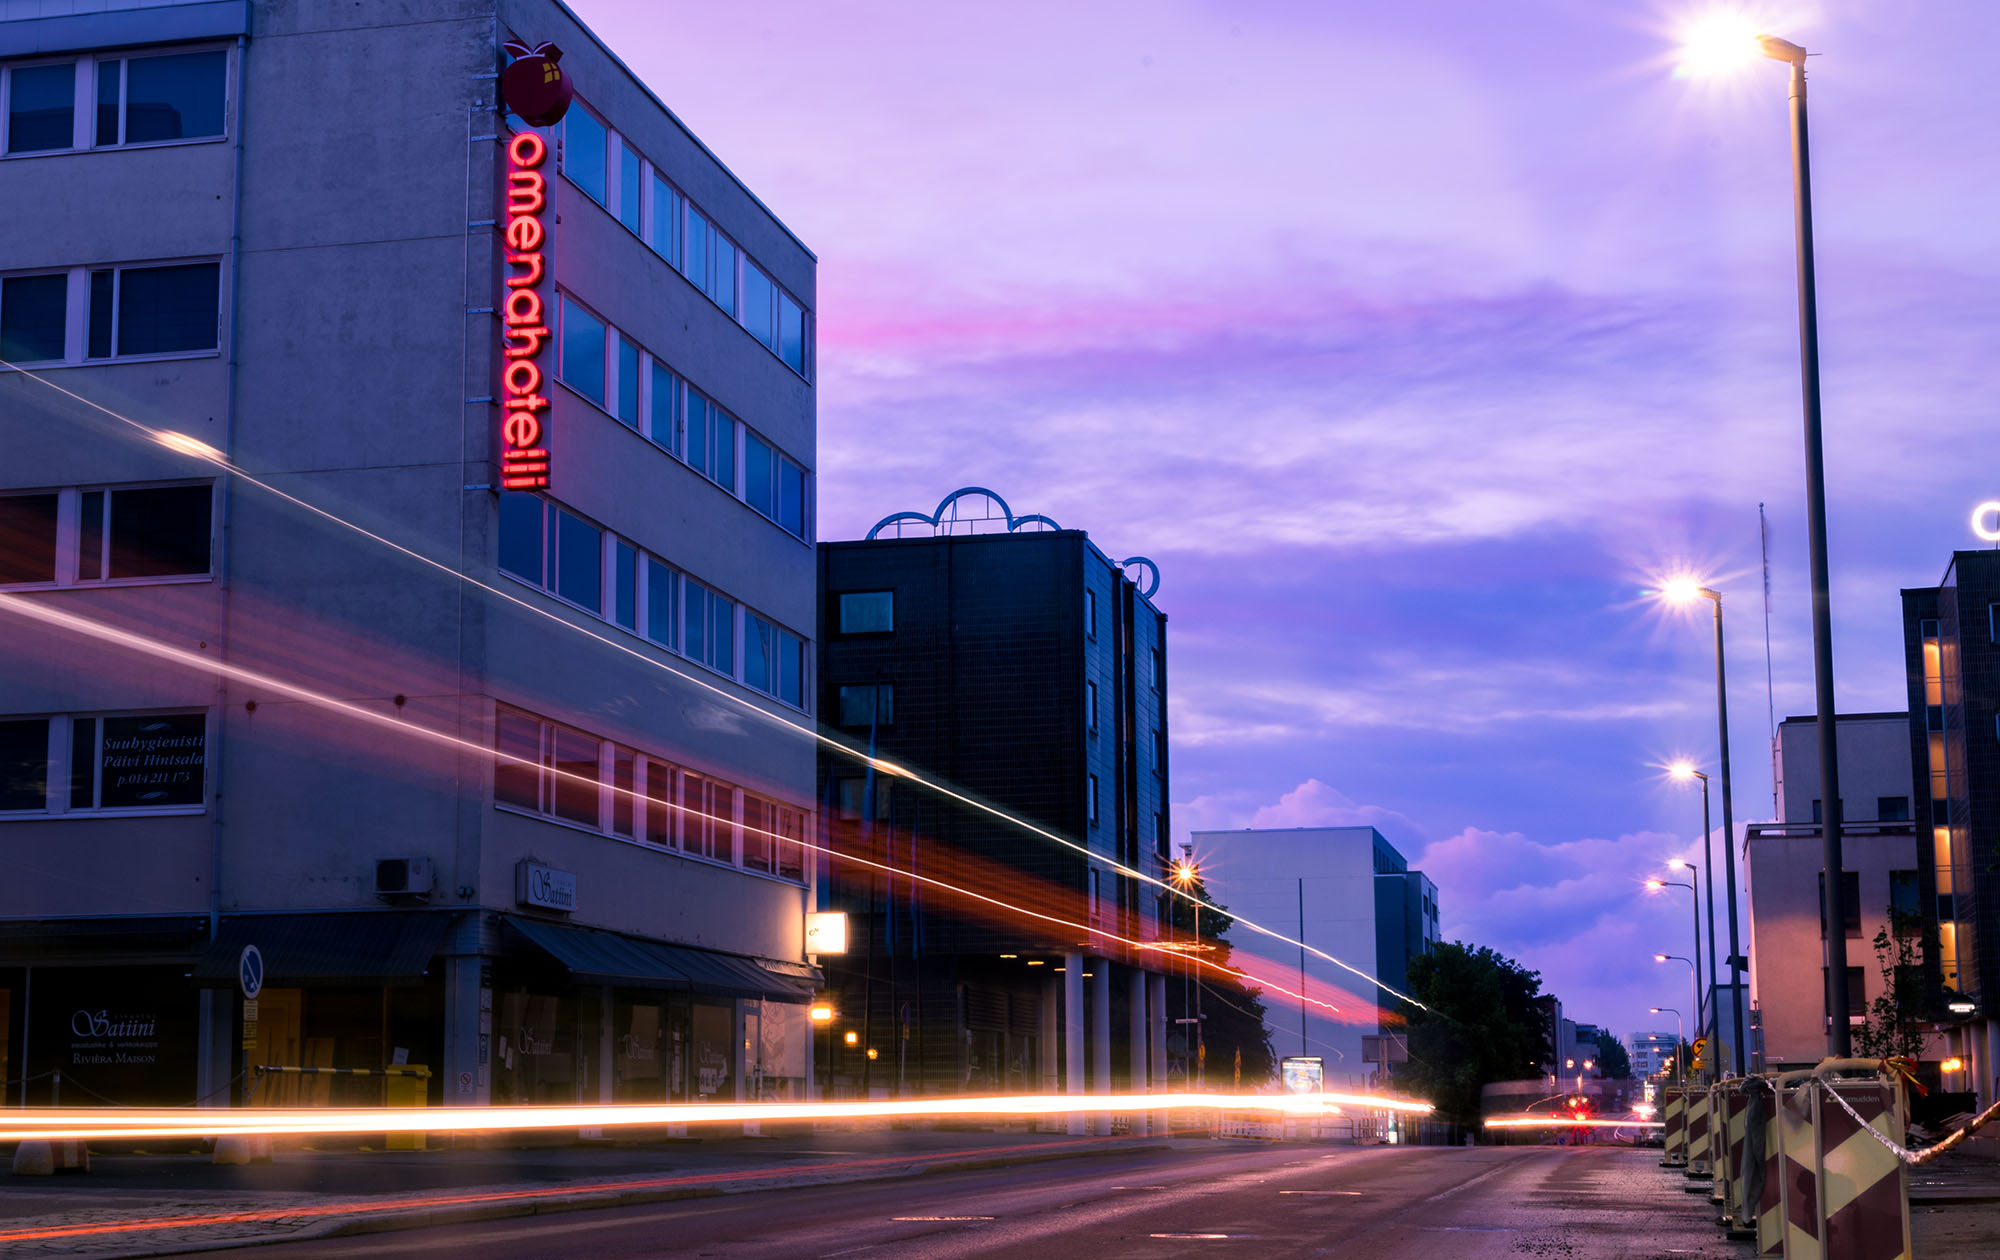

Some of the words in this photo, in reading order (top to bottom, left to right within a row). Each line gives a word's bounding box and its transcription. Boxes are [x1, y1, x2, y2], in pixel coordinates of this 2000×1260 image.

[502, 131, 550, 489] omenahotelli
[103, 753, 141, 768] Päivi
[143, 752, 204, 767] Hintsala
[532, 870, 572, 907] Satiini
[72, 1009, 155, 1037] Satiini
